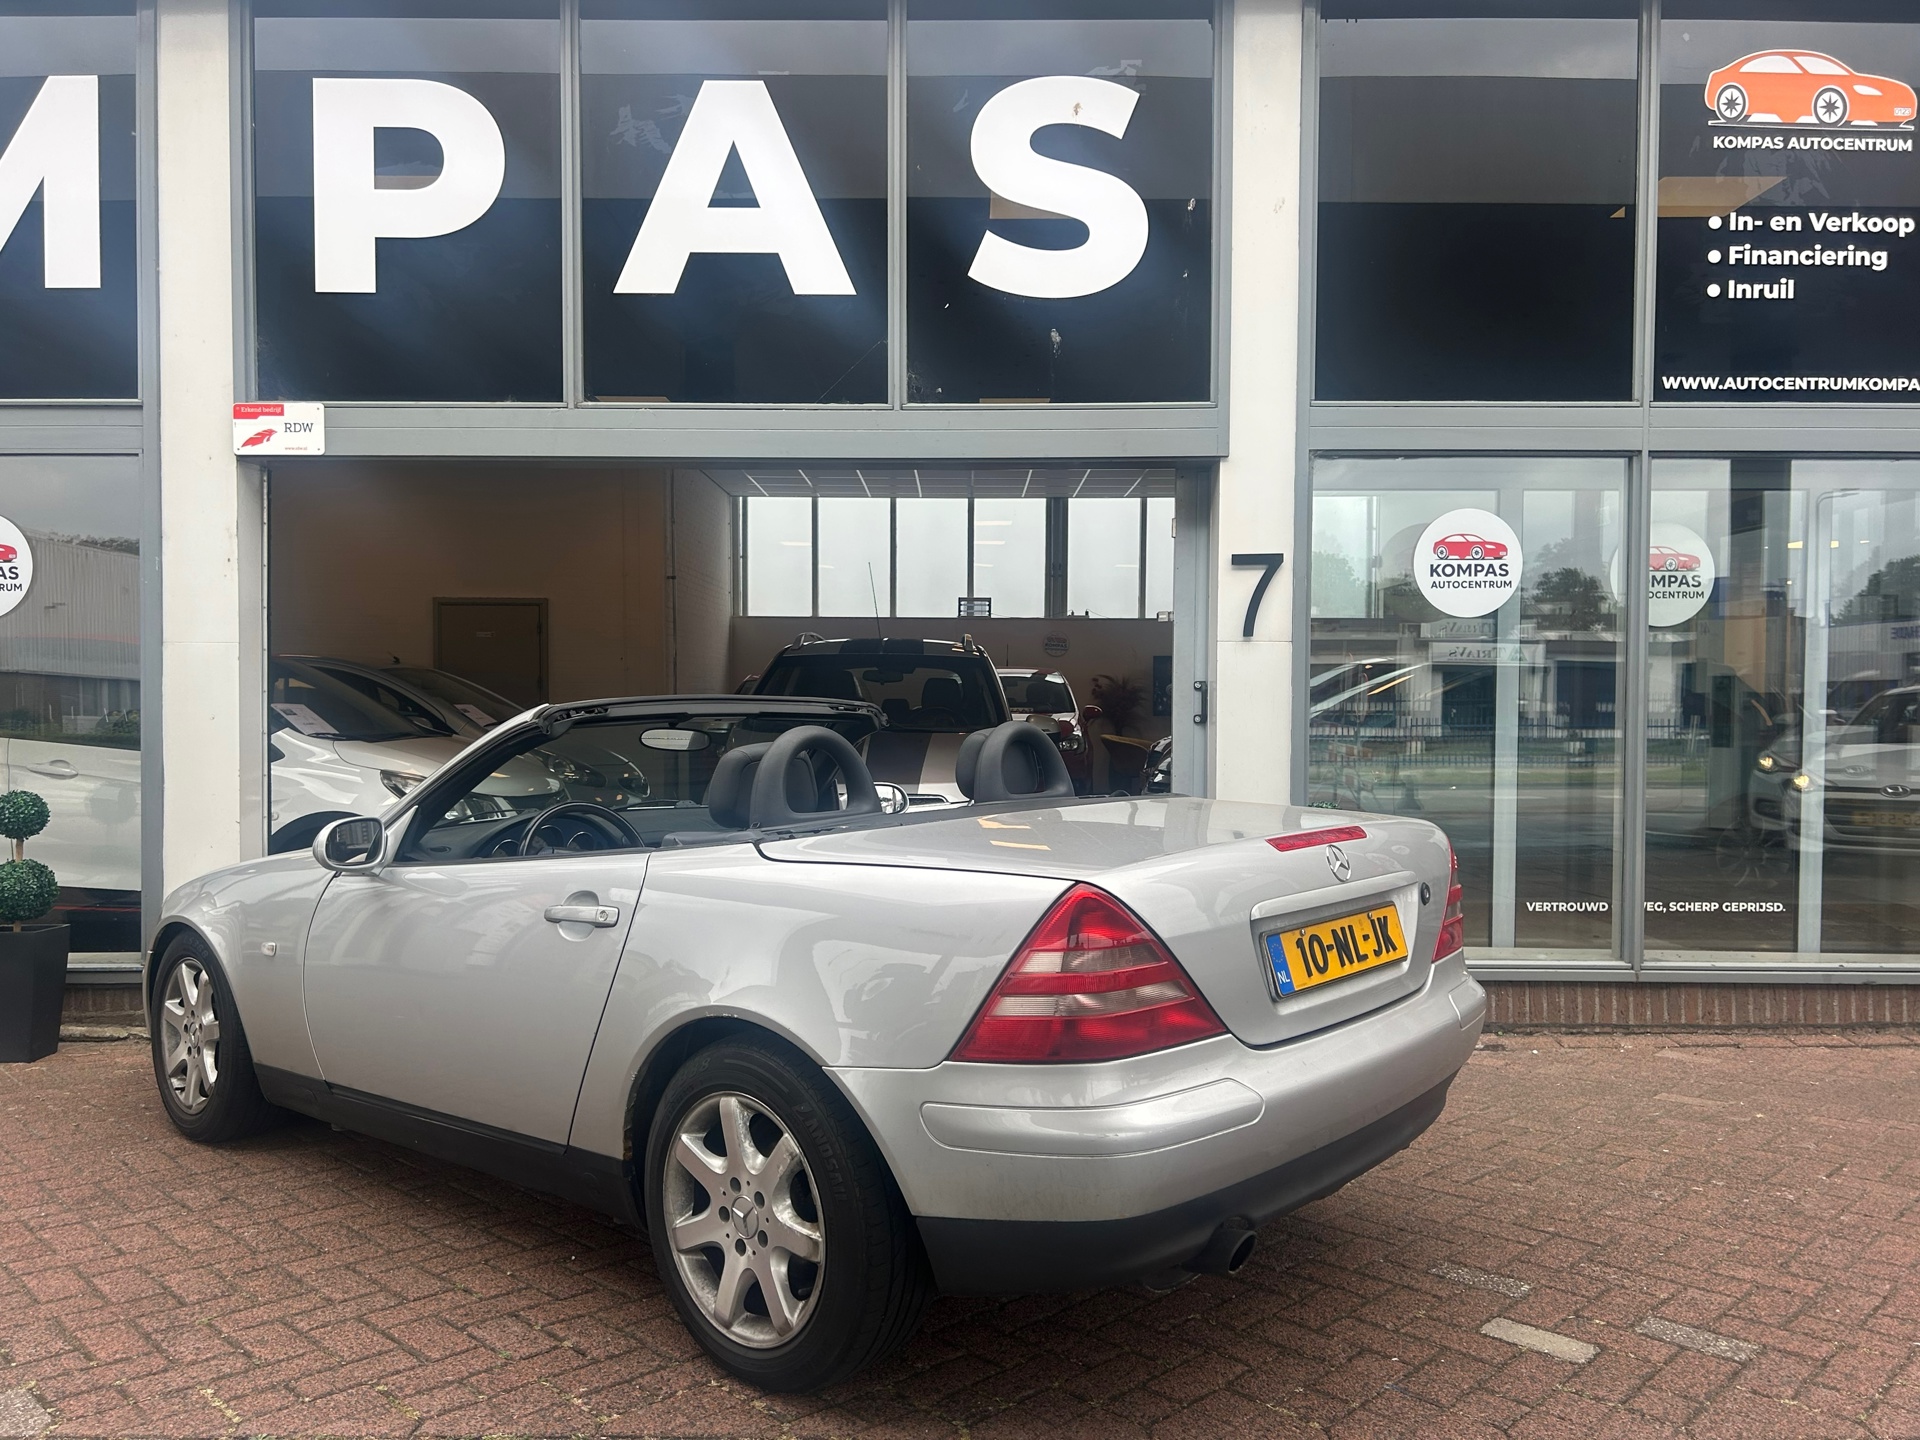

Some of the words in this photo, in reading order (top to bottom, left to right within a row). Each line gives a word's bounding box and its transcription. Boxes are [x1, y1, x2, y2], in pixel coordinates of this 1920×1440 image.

[1713, 136, 1784, 150] KOMPAS
[1787, 137, 1913, 151] AUTOCENTRUM
[1729, 213, 1763, 231] In-
[1770, 217, 1801, 232] en
[1809, 213, 1915, 237] Verkoop
[1728, 244, 1888, 271] Financiering
[1728, 278, 1794, 299] Inruil
[1662, 376, 1920, 391] WWW.AUTOCENTRUMKOMPA
[262, 406, 282, 414] bedrijf
[284, 422, 314, 433] RDW
[1430, 563, 1509, 578] KOMPAS
[1431, 580, 1512, 589] AUTOCENTRUM
[1648, 574, 1702, 588] MPAS
[1231, 553, 1284, 637] 7
[1526, 902, 1608, 912] VERTROUWD
[1644, 902, 1667, 913] EG,
[1669, 902, 1719, 912] SCHERP
[1722, 902, 1786, 912] GEPRIJSD.
[1296, 915, 1398, 978] 10-NL-JK
[1278, 970, 1290, 984] NL
